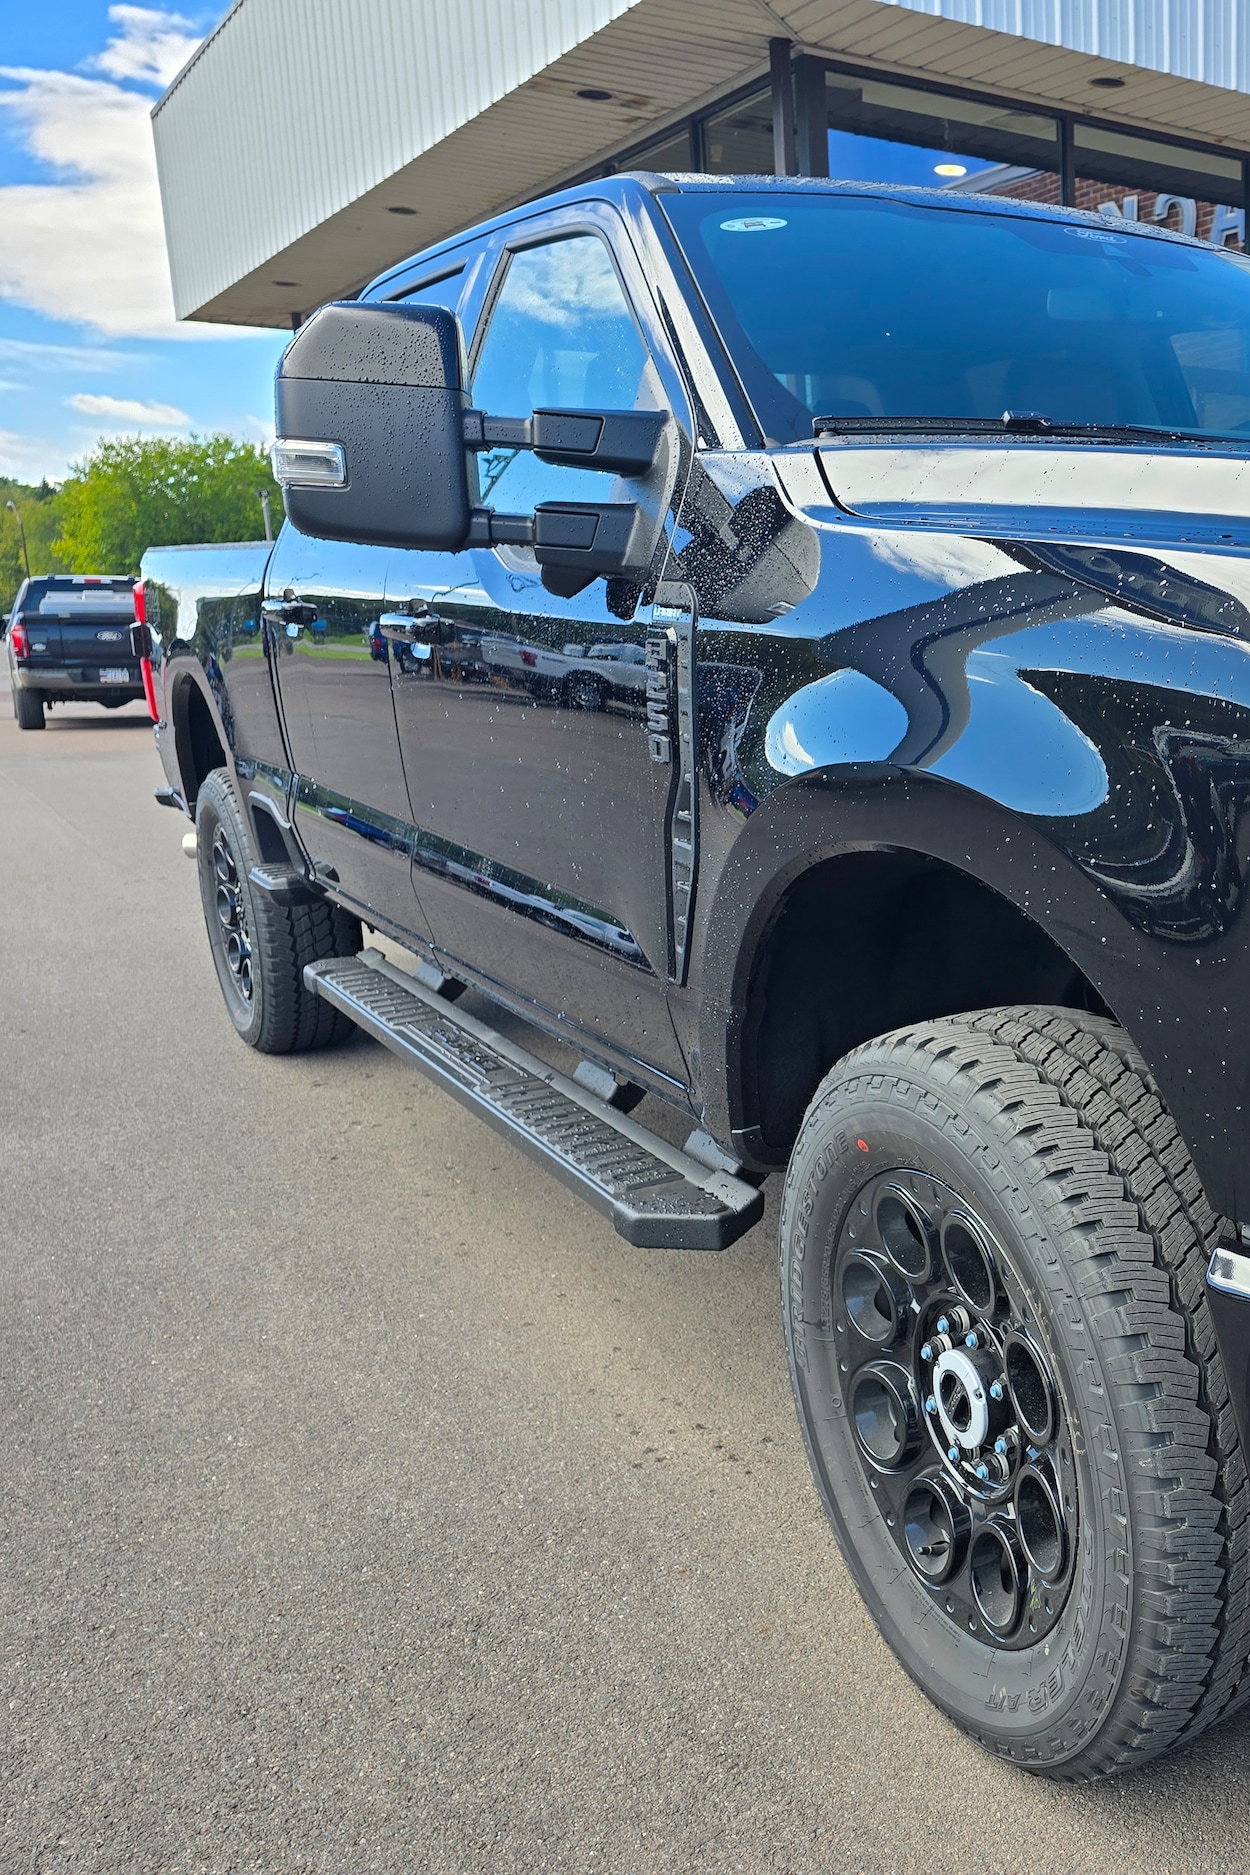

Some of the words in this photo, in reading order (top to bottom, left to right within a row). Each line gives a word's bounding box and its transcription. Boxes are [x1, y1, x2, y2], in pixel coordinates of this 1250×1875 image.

[1074, 229, 1119, 243] Ford
[789, 1128, 849, 1373] BRIDGESTONE
[984, 1691, 1022, 1714] A/T
